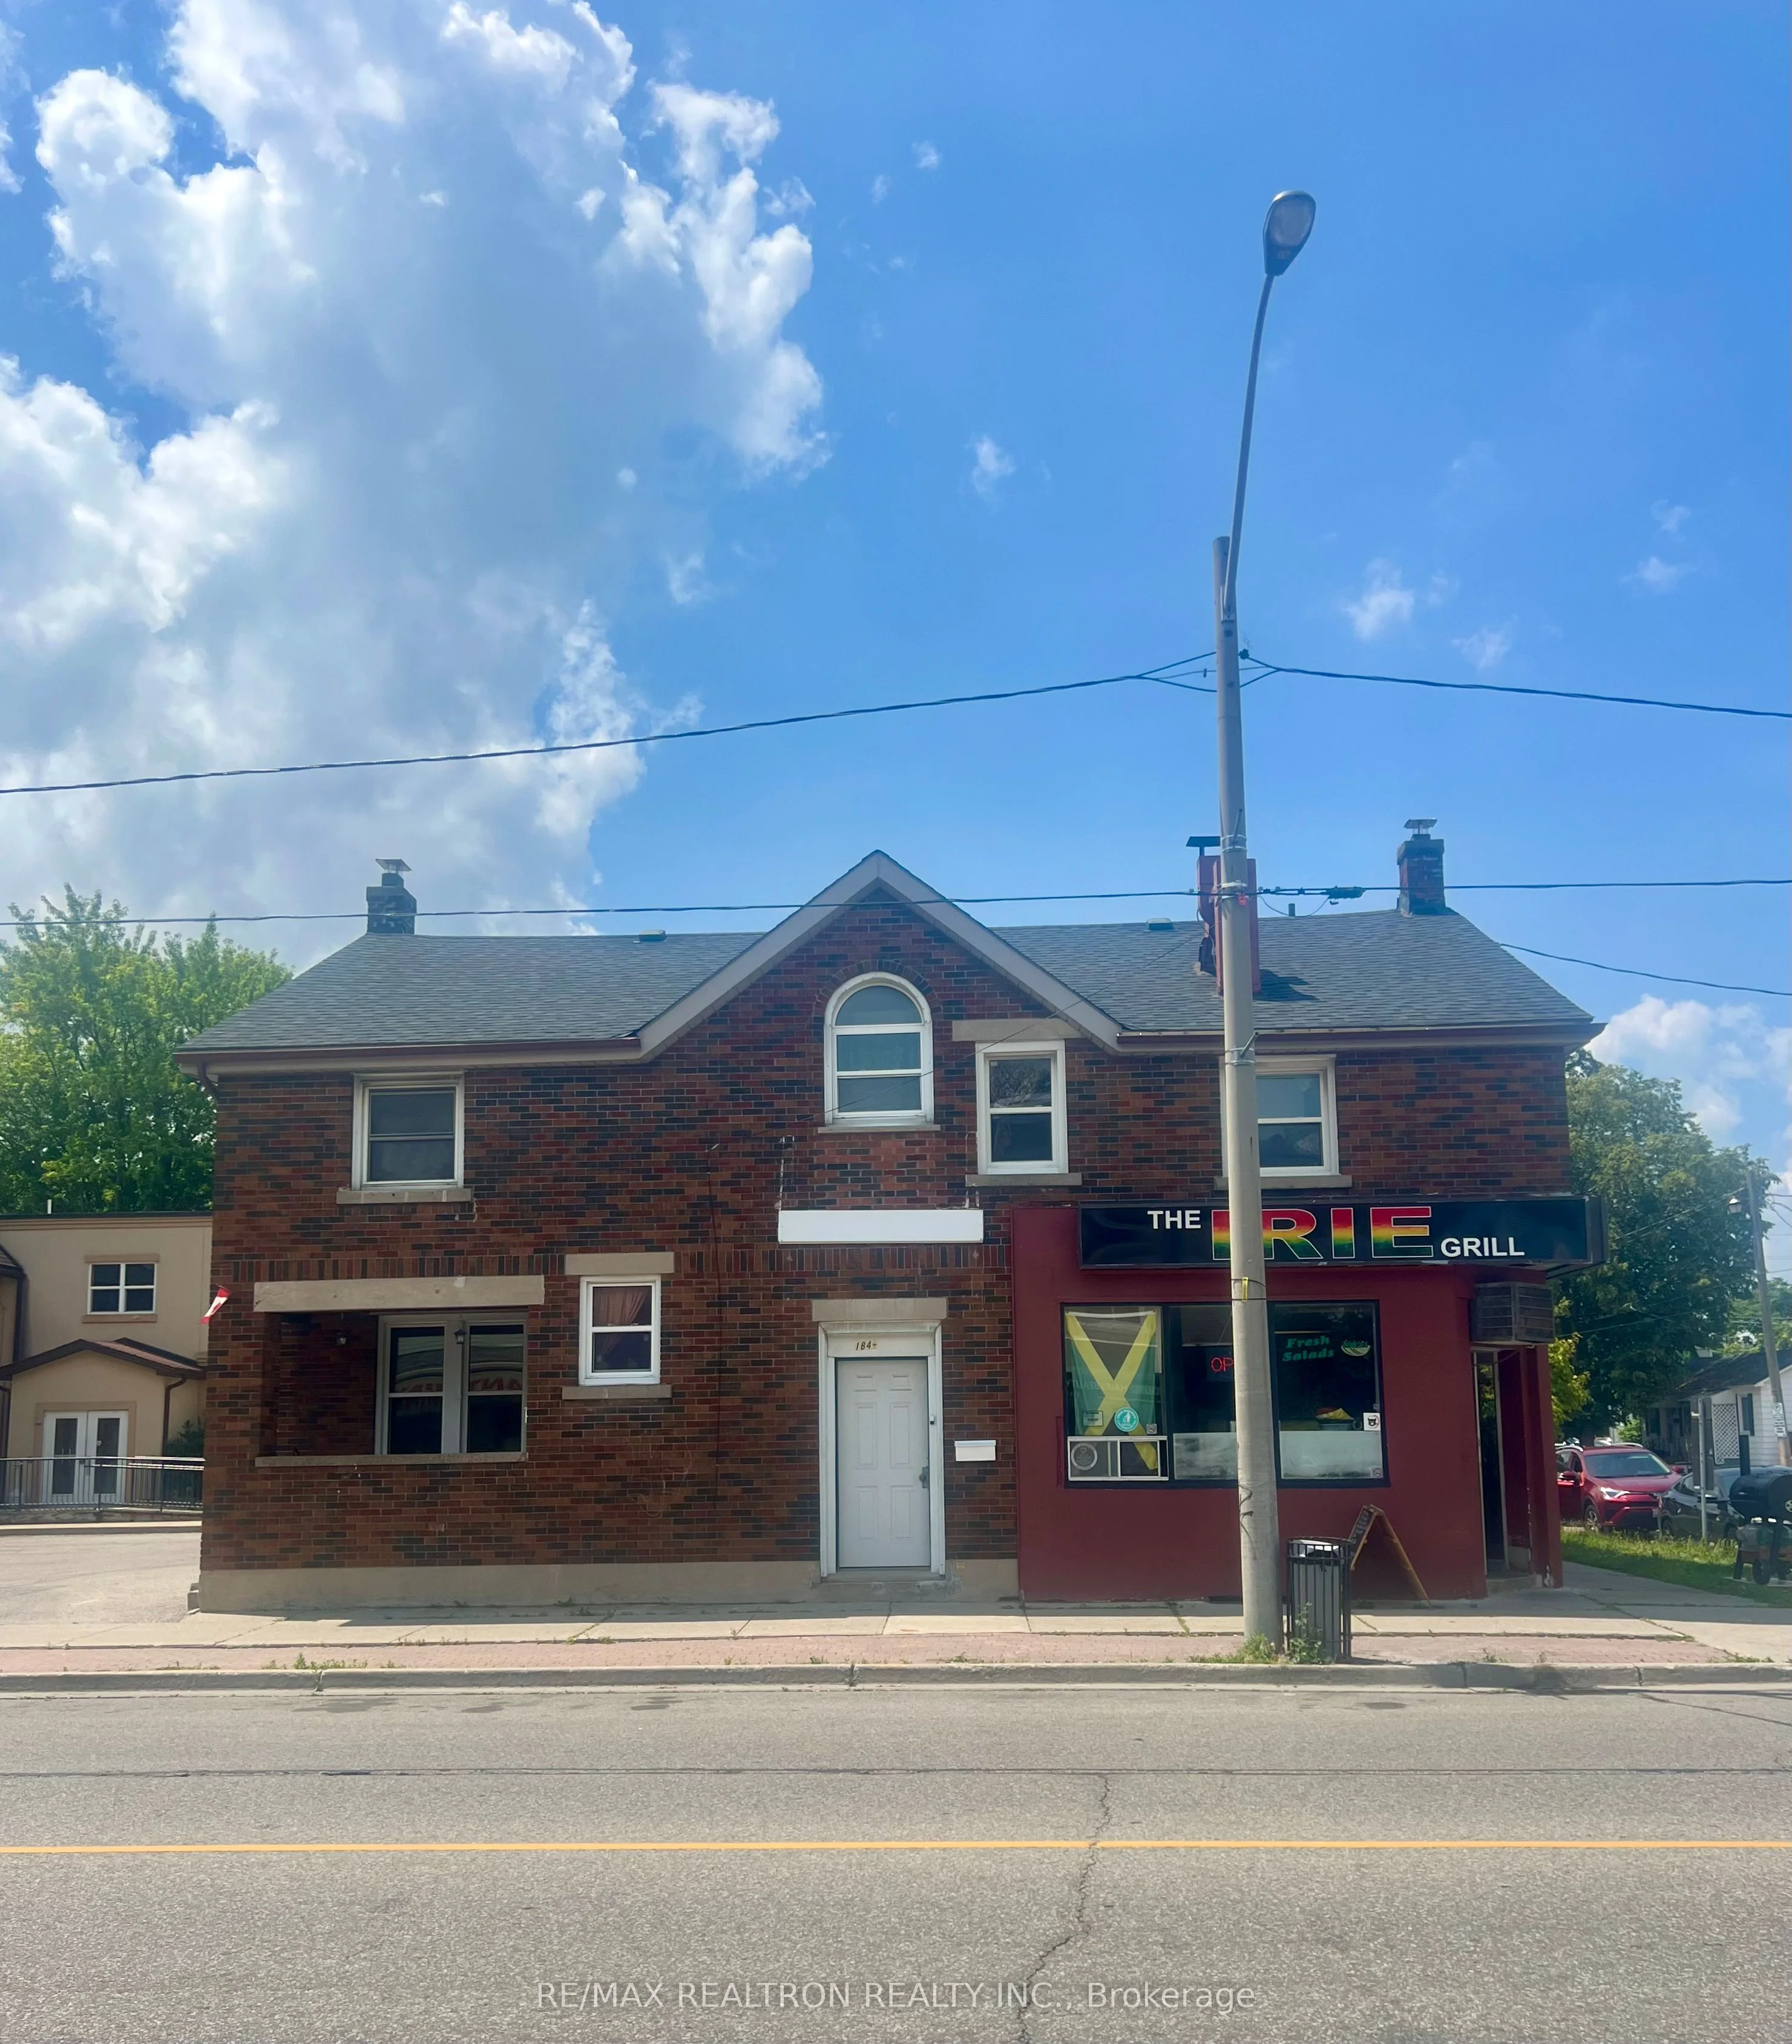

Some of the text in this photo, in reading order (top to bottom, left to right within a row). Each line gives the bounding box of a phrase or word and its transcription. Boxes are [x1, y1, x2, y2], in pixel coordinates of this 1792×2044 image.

[1147, 1210, 1201, 1229] THE
[1440, 1237, 1526, 1258] GRILL
[1286, 1335, 1330, 1349] Fresh
[1282, 1348, 1335, 1362] Salads
[1210, 1356, 1235, 1373] OP
